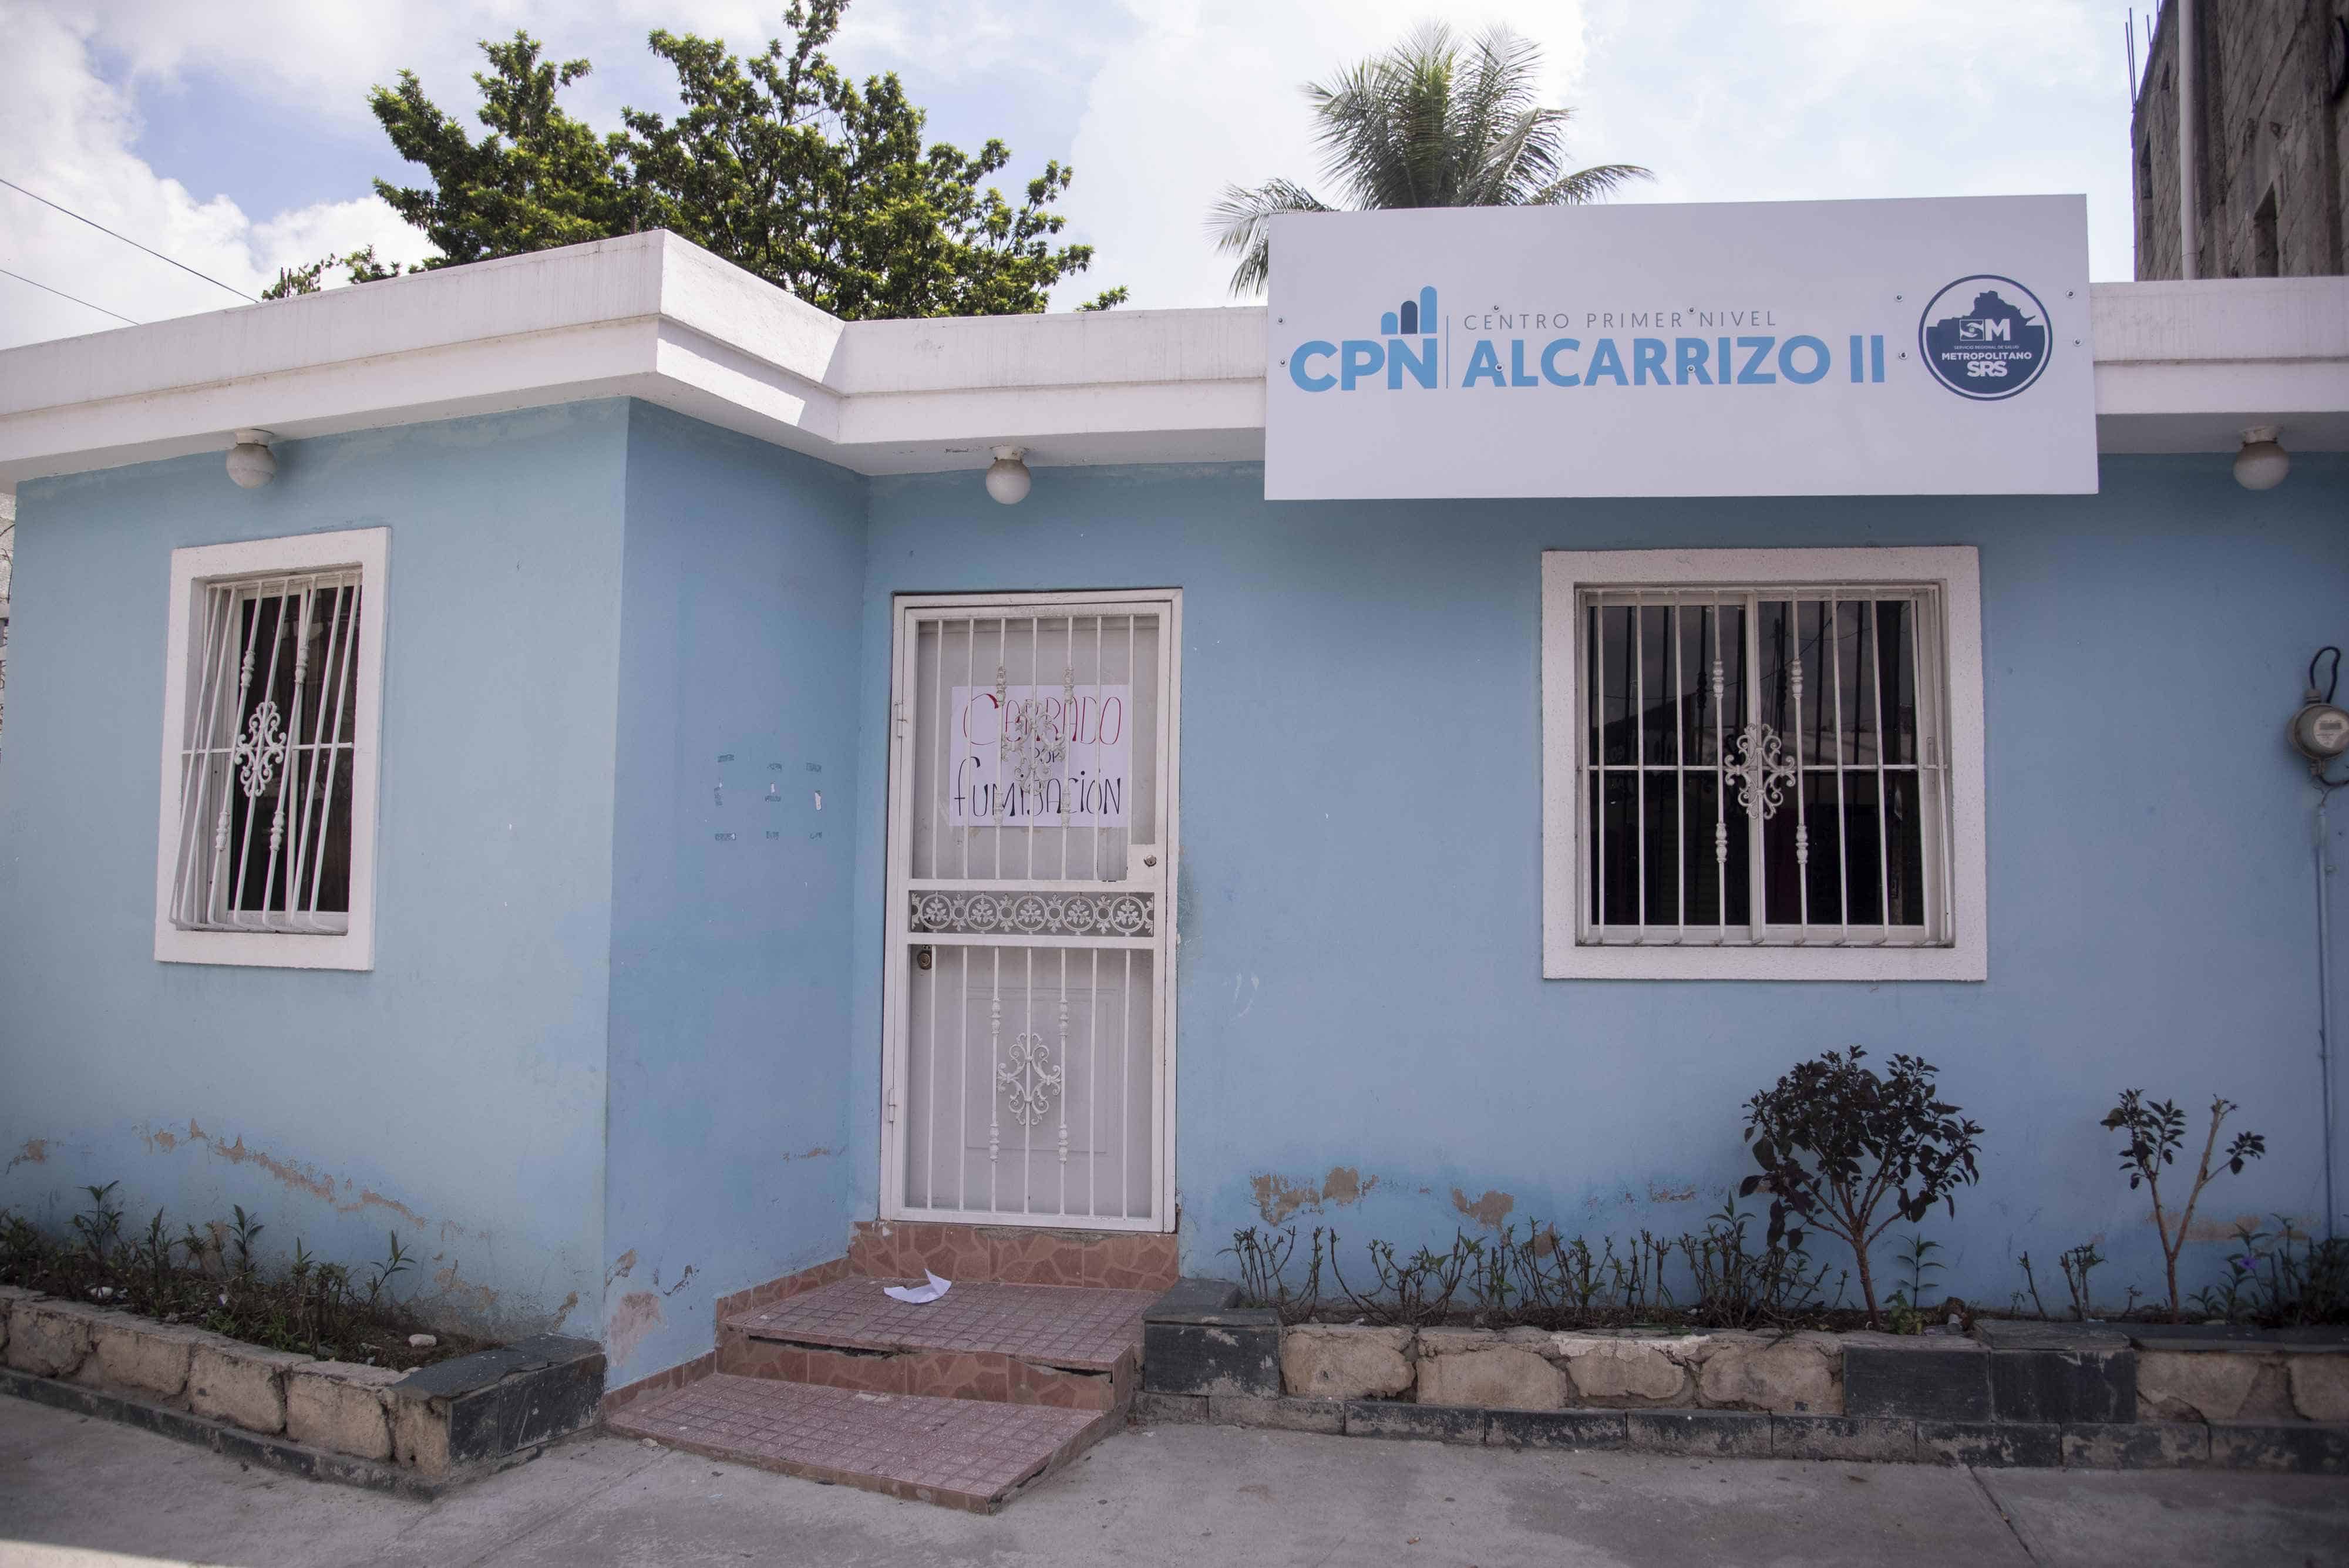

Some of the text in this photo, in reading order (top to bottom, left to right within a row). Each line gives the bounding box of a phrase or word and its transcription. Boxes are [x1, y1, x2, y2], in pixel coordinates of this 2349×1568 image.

[1464, 310, 1776, 331] CENTRO PRIMER NIVEL
[1289, 338, 1438, 392] CPN
[1461, 334, 1885, 388] ALCARRIZO II
[1941, 352, 2032, 361] METROPOLITANO
[1967, 360, 2008, 378] SRS
